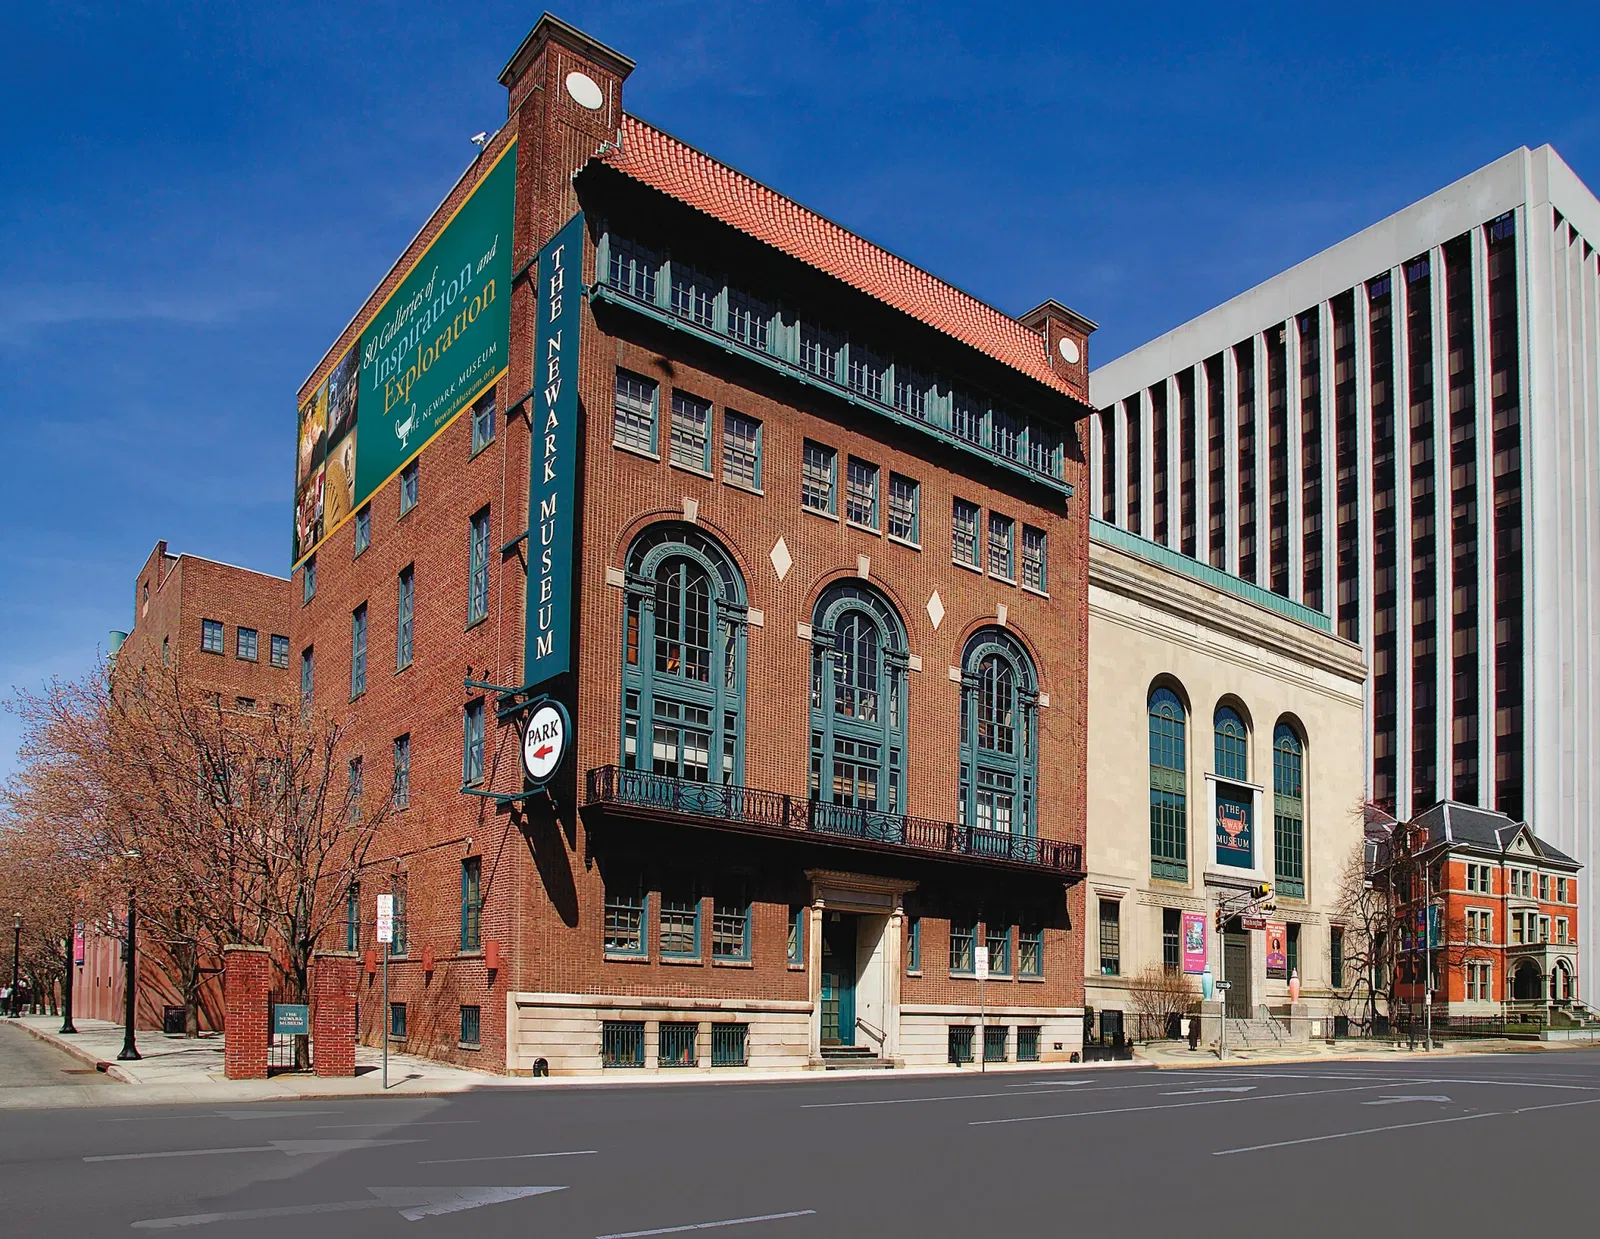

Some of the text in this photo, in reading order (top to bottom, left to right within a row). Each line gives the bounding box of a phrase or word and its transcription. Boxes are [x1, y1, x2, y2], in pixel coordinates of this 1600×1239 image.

[363, 265, 439, 369] 80 Galleries of
[373, 233, 499, 391] Inspiration and
[383, 279, 497, 416] Exploration
[422, 383, 456, 421] NEWARK
[458, 342, 497, 387] MUSEUM
[535, 244, 565, 661] THE NEWARK MUSEUM
[527, 719, 559, 747] PARK
[1216, 817, 1250, 833] NEWARK
[1216, 834, 1250, 849] MUSEUM
[1224, 803, 1240, 815] THE
